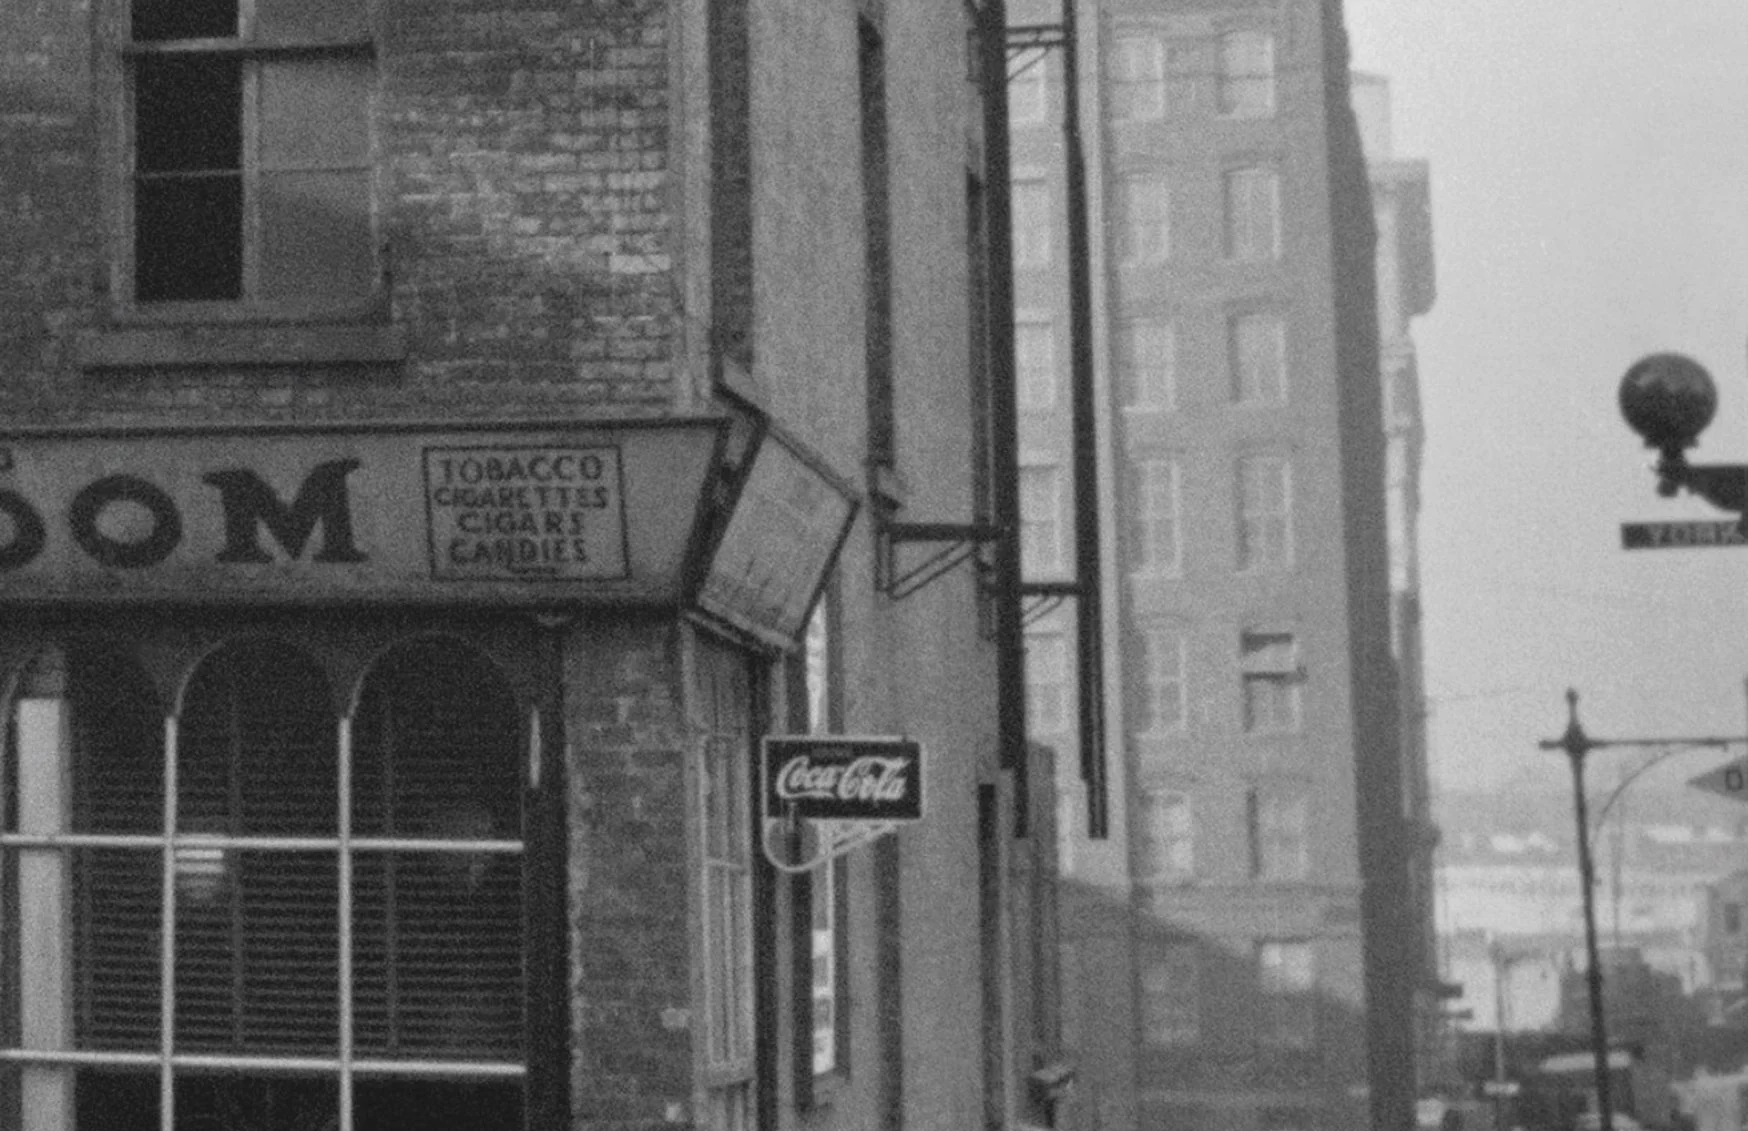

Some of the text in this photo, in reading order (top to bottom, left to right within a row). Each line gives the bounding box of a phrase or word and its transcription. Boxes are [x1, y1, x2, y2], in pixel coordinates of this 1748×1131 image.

[439, 455, 603, 484] TOBACCO
[434, 486, 608, 508] CIGARETTES
[457, 510, 585, 536] CIGARS
[449, 537, 588, 565] CANDIES
